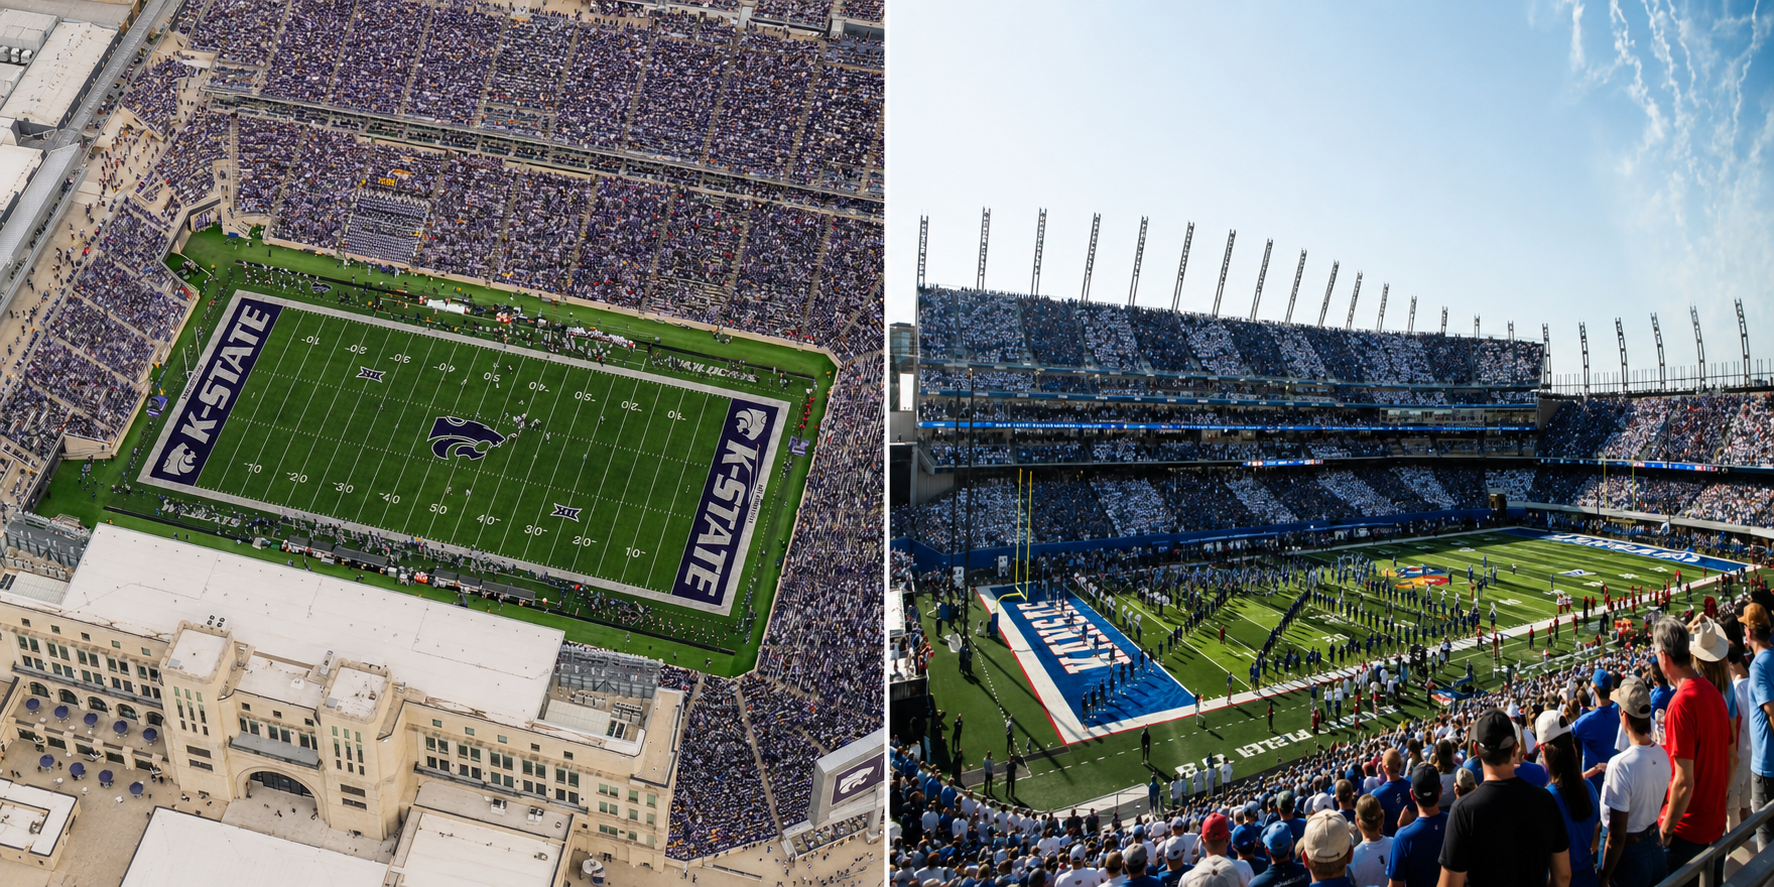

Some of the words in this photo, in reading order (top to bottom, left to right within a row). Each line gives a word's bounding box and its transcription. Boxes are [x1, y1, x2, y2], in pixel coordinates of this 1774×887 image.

[180, 305, 271, 445] K-STATE
[247, 462, 262, 474] 10
[289, 472, 308, 484] 20
[335, 482, 354, 494] 30
[382, 492, 400, 504] 40
[429, 503, 448, 515] 50
[476, 514, 495, 525] 40
[684, 439, 757, 597] K-STATE
[524, 524, 543, 536] 30
[572, 535, 592, 547] 20
[625, 546, 640, 558] 10
